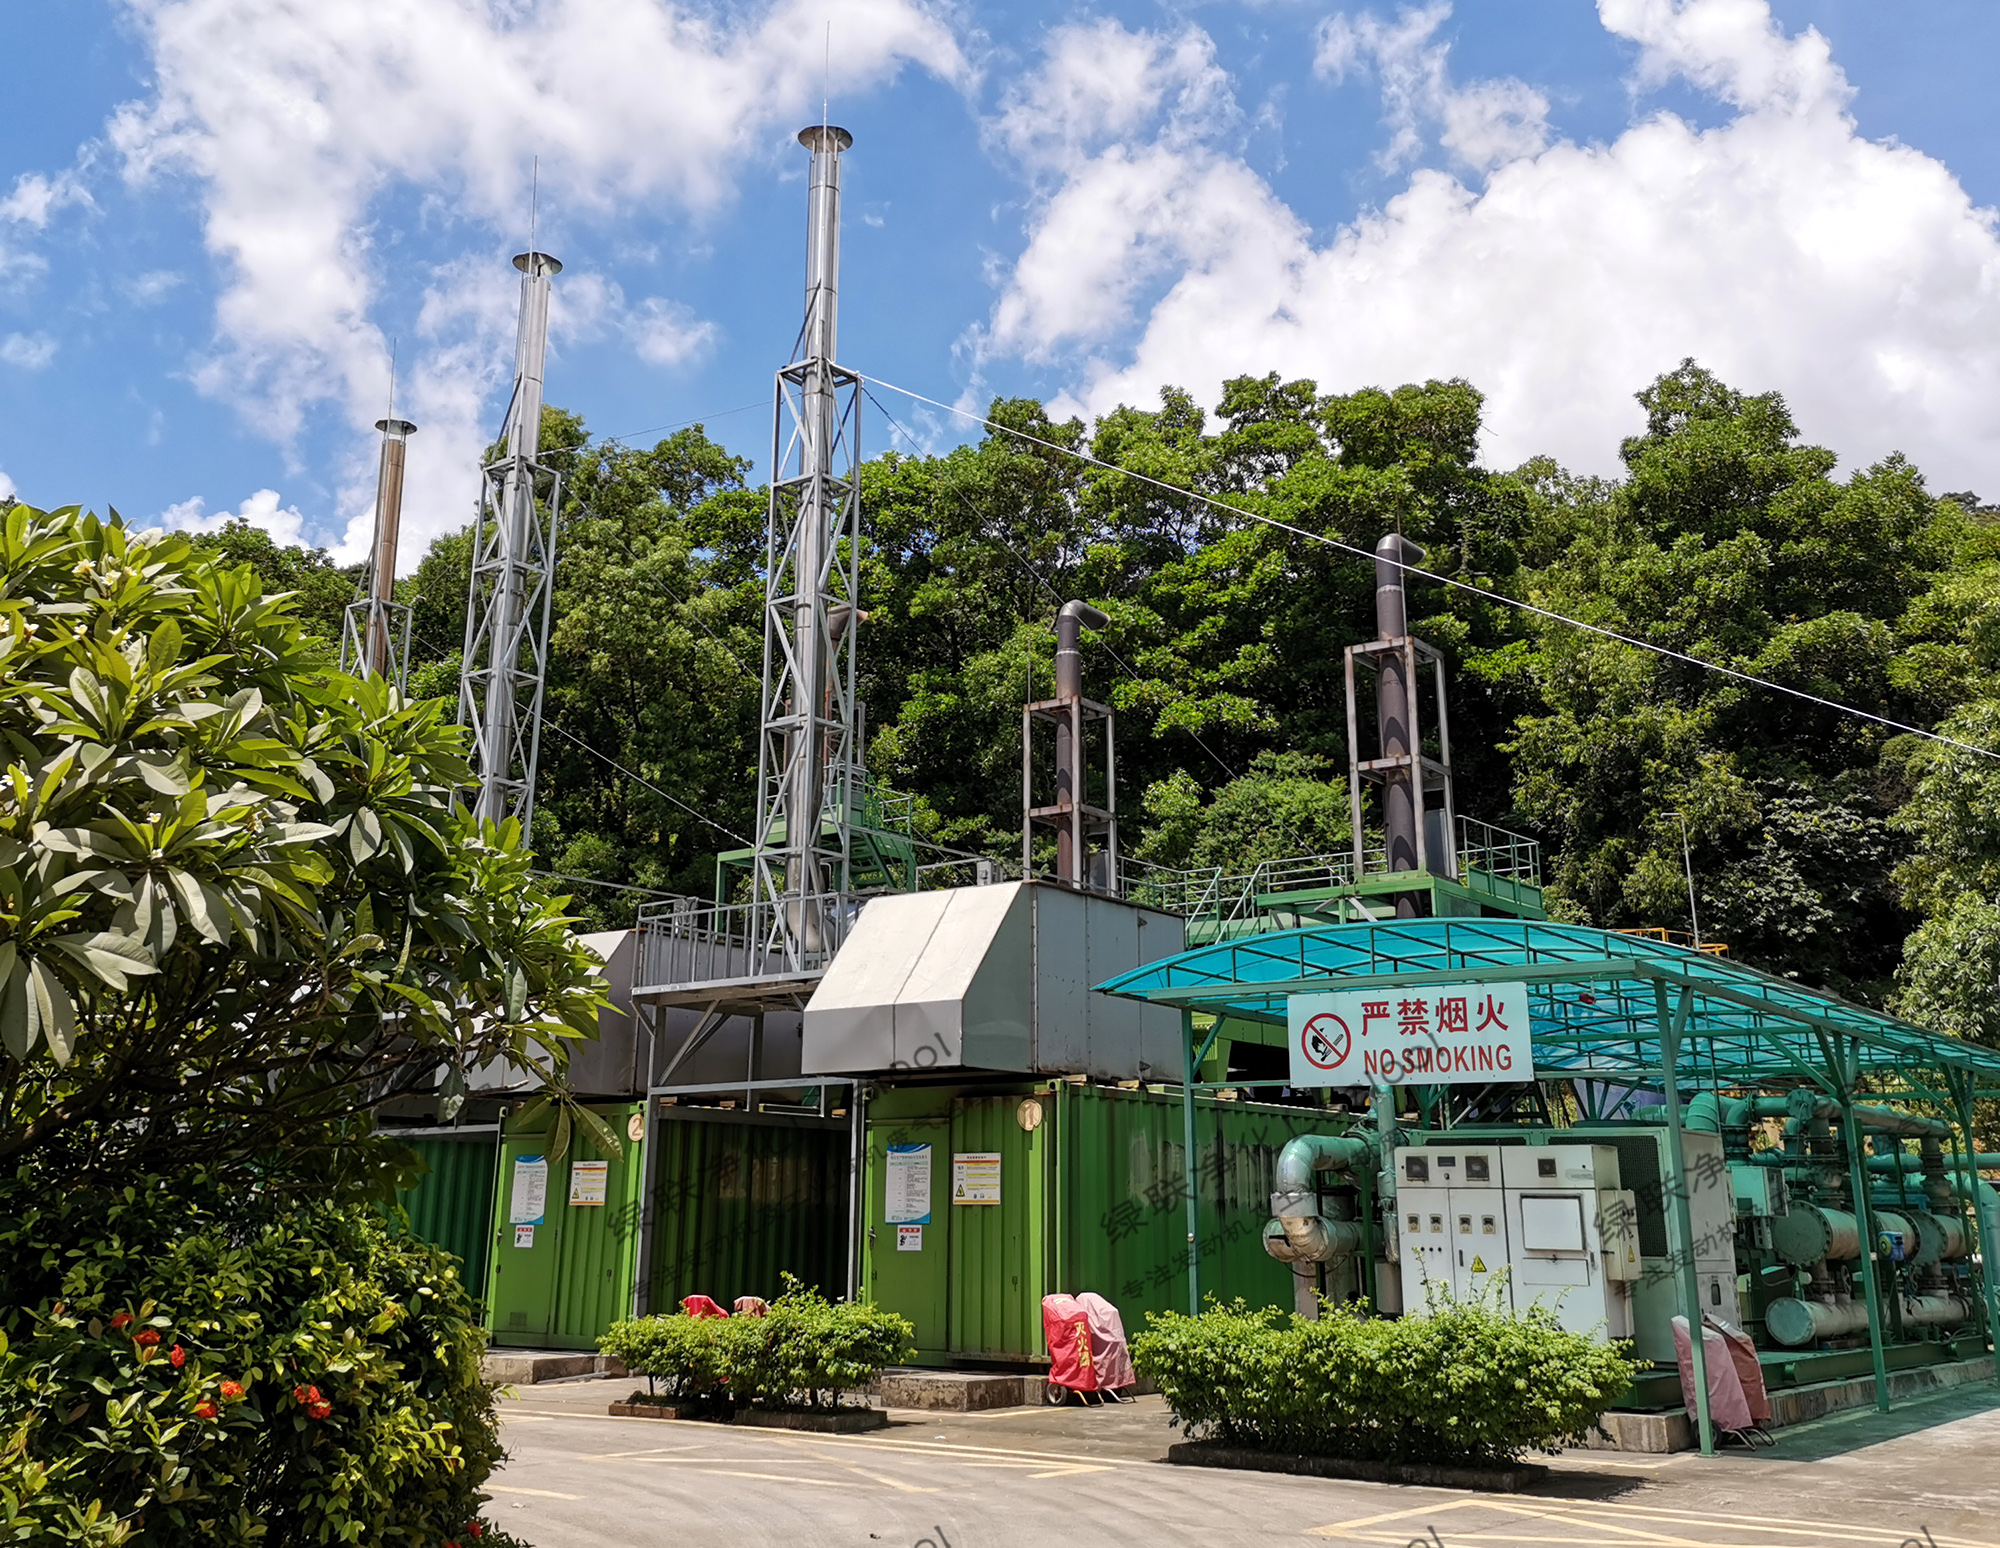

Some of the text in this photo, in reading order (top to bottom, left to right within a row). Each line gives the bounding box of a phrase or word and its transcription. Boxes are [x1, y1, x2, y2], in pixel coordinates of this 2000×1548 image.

[1361, 994, 1509, 1036] 严禁烟火
[1364, 1044, 1512, 1075] NO SMOKING
[632, 1117, 643, 1136] 2
